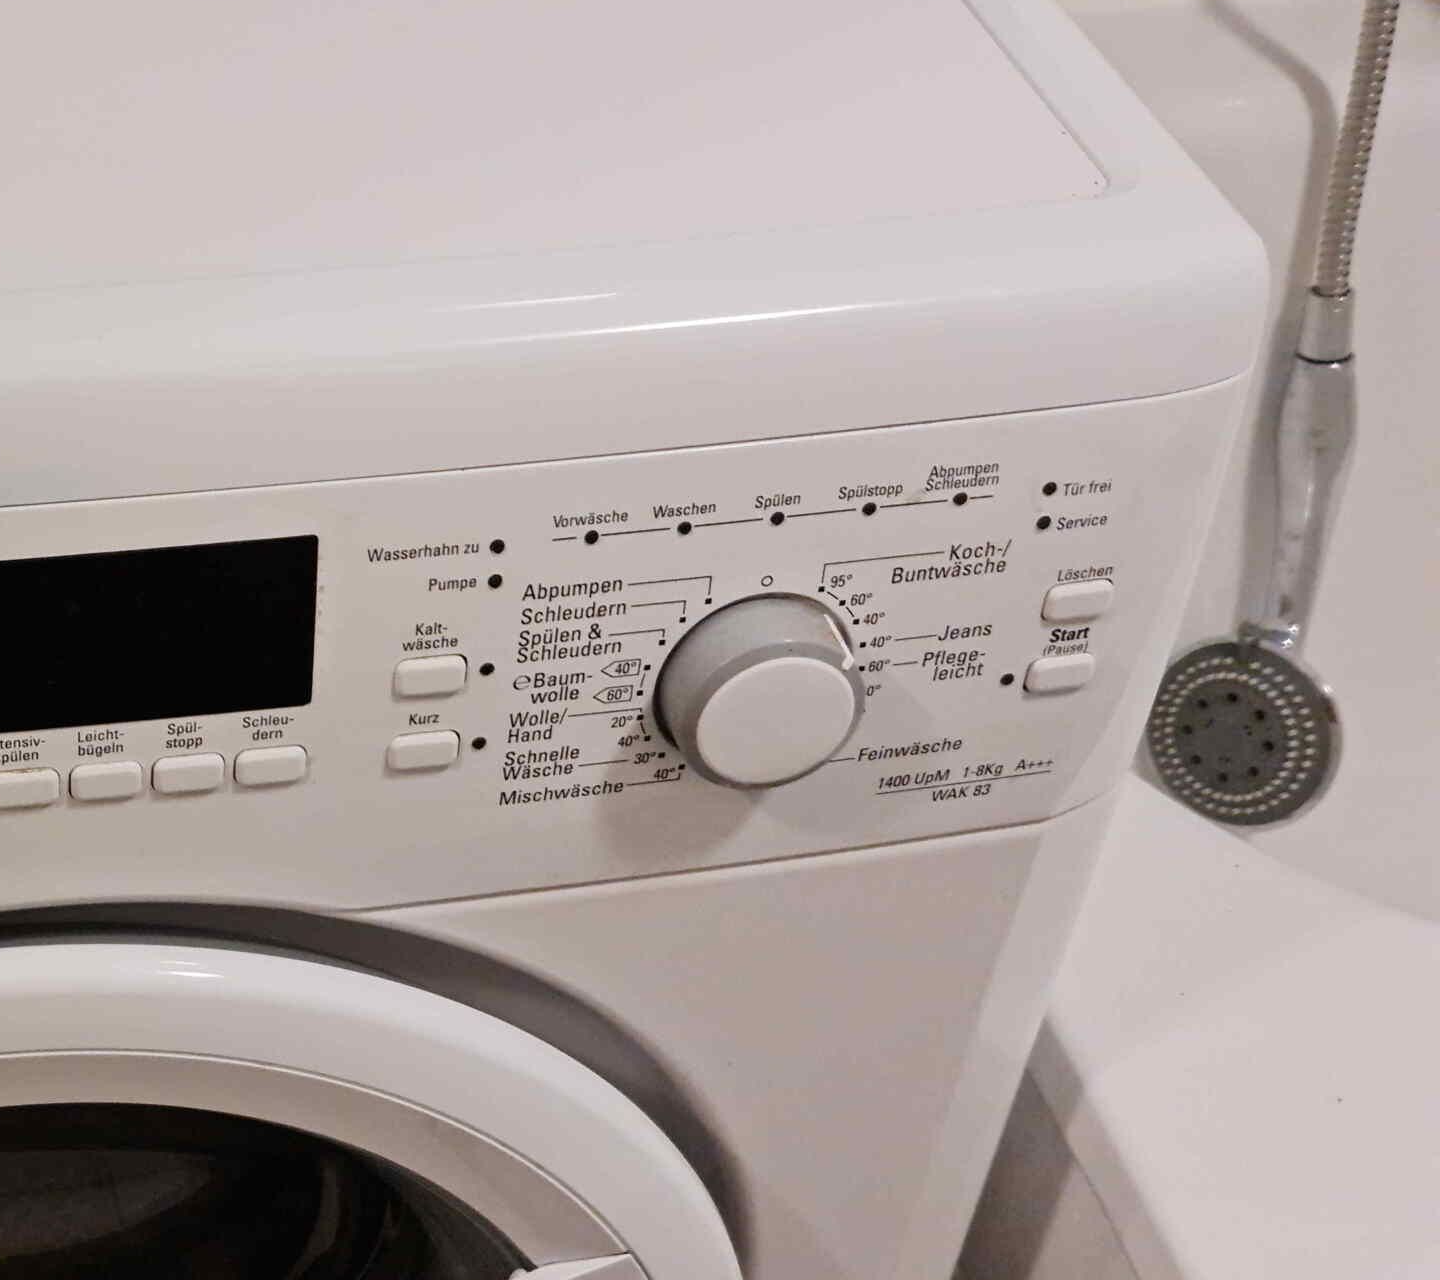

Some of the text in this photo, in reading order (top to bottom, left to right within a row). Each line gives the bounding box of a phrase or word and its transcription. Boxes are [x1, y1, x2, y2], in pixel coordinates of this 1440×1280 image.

[929, 462, 999, 480] Abpumpen
[838, 483, 903, 500] Spülstopp
[925, 473, 1000, 492] Schleudern
[1063, 479, 1112, 497] Tür frei
[652, 502, 716, 519] Waschen
[754, 493, 801, 510] Spülen
[552, 510, 628, 529] Vorwäsche
[1057, 513, 1108, 530] Service
[367, 542, 480, 562] Wasserhahn zu
[891, 557, 1007, 585] Buntwäsche
[1057, 566, 1113, 582] Löschen
[428, 577, 477, 592] Pumpe
[522, 577, 623, 601] Abpumpen
[520, 601, 627, 625] Schleudern
[415, 623, 448, 637] Kalt-
[518, 623, 602, 649] Spülen &
[937, 624, 992, 641] Jeans
[1049, 627, 1090, 643] Start
[402, 635, 458, 652] wäsche
[516, 640, 622, 664] Schleudern
[1043, 641, 1089, 656] (Pause)
[921, 649, 986, 670] Pflege-
[932, 663, 984, 682] leicht
[530, 688, 579, 704] wolle
[242, 714, 295, 729] Schleu-
[408, 712, 440, 727] Kurz
[509, 709, 568, 728] Wolle/
[77, 729, 125, 744] Leicht-
[167, 721, 203, 738] Spül-
[252, 727, 284, 742] dern
[507, 726, 553, 744] Hand
[77, 740, 124, 757] bügeln
[165, 734, 203, 751] stopp
[857, 737, 963, 762] Feinwäsche
[504, 746, 580, 766] Schnelle
[502, 761, 574, 781] Wäsche
[878, 773, 910, 789] 1400
[914, 769, 950, 786] UpM
[963, 763, 1004, 779] 1-8Kg
[499, 780, 624, 806] Mischwäsche
[932, 784, 969, 802] WAK
